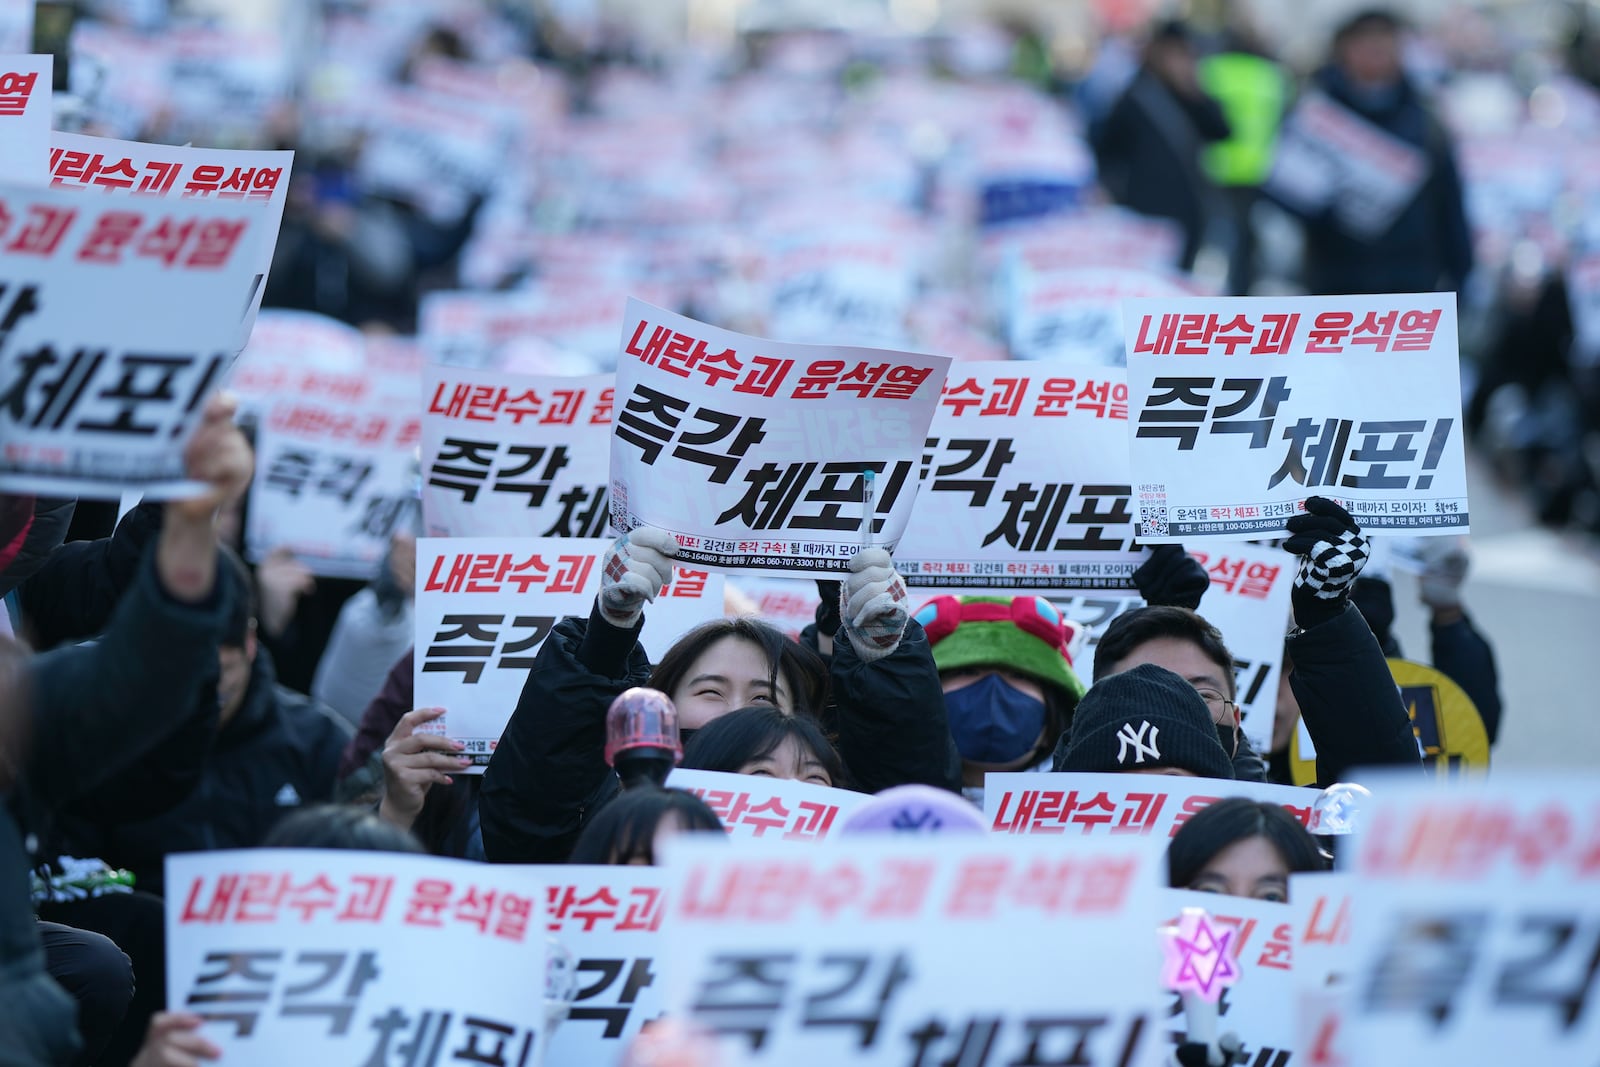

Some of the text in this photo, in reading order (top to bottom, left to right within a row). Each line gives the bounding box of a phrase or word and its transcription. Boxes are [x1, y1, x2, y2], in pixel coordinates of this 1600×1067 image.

[76, 209, 248, 272] 윤석열
[625, 320, 934, 400] 내란수괴 윤석열
[1133, 308, 1443, 356] 내란수괴 윤석열
[427, 381, 586, 426] 내란수괴
[1135, 375, 1292, 451] 즉각
[614, 383, 768, 484] 즉각
[1267, 417, 1455, 491] 체포!
[428, 437, 569, 509] 즉각
[714, 460, 914, 534] 체포!
[1177, 508, 1207, 521] 윤석열
[1210, 507, 1231, 520] 즉각
[1234, 505, 1260, 518] 체포!
[1262, 502, 1295, 517] 김건희
[1357, 502, 1388, 514] 때까지
[1391, 502, 1427, 514] 모이자!
[1197, 523, 1225, 532] 신한은행
[1226, 520, 1280, 531] 100-036-164860
[423, 553, 596, 594] 내란수괴
[703, 539, 735, 553] 김건희
[738, 541, 759, 553] 즉각
[761, 542, 787, 554] 구속!
[803, 543, 835, 557] 때까지
[751, 557, 765, 565] ARS
[766, 557, 814, 567] 060-707-3300
[922, 562, 943, 574] 즉각
[946, 562, 970, 574] 체포!
[974, 562, 1003, 574] 김건희
[1007, 563, 1027, 575] 즉각
[1031, 563, 1055, 575] 구속!
[1070, 564, 1100, 576] 때까지
[1117, 720, 1161, 764] NY
[685, 786, 840, 844] 란수괴
[991, 790, 1168, 836] 내란수괴
[179, 871, 535, 942] 내란수괴 윤석열
[184, 949, 381, 1039] 즉각
[690, 950, 912, 1052] 즉각
